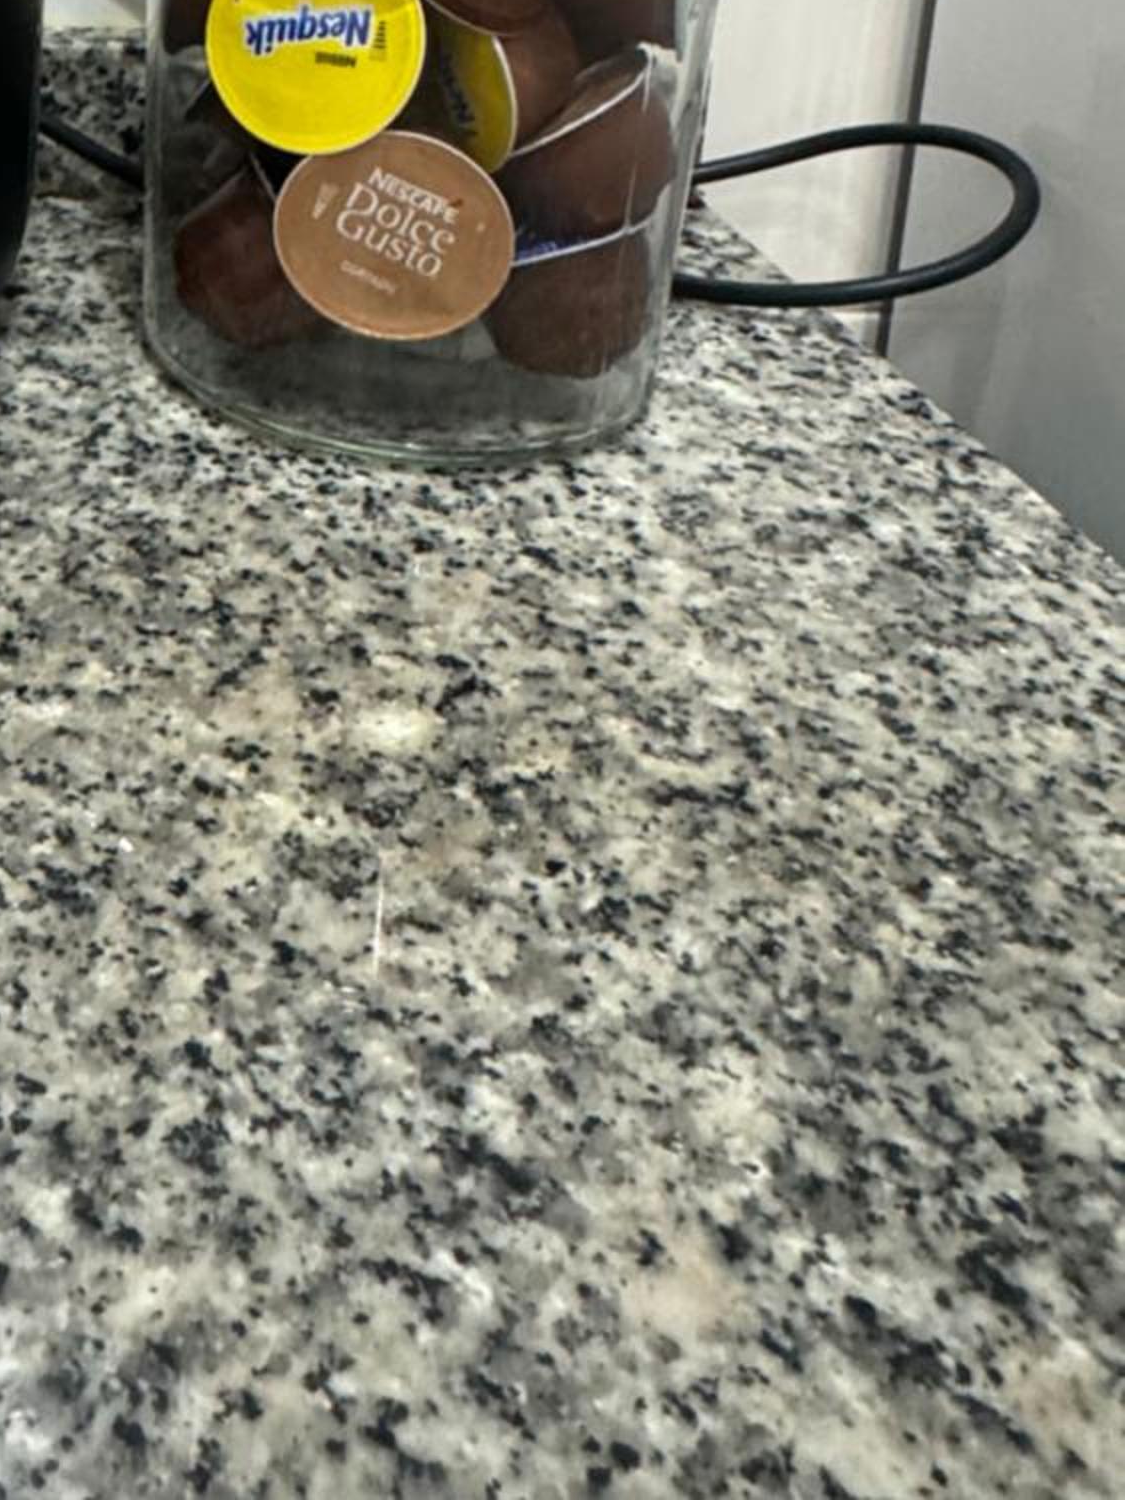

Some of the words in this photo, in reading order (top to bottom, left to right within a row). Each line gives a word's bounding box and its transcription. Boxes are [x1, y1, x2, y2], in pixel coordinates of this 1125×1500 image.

[245, 4, 372, 56] Nesquik
[336, 209, 443, 278] Gusto
[346, 181, 456, 255] Dolce
